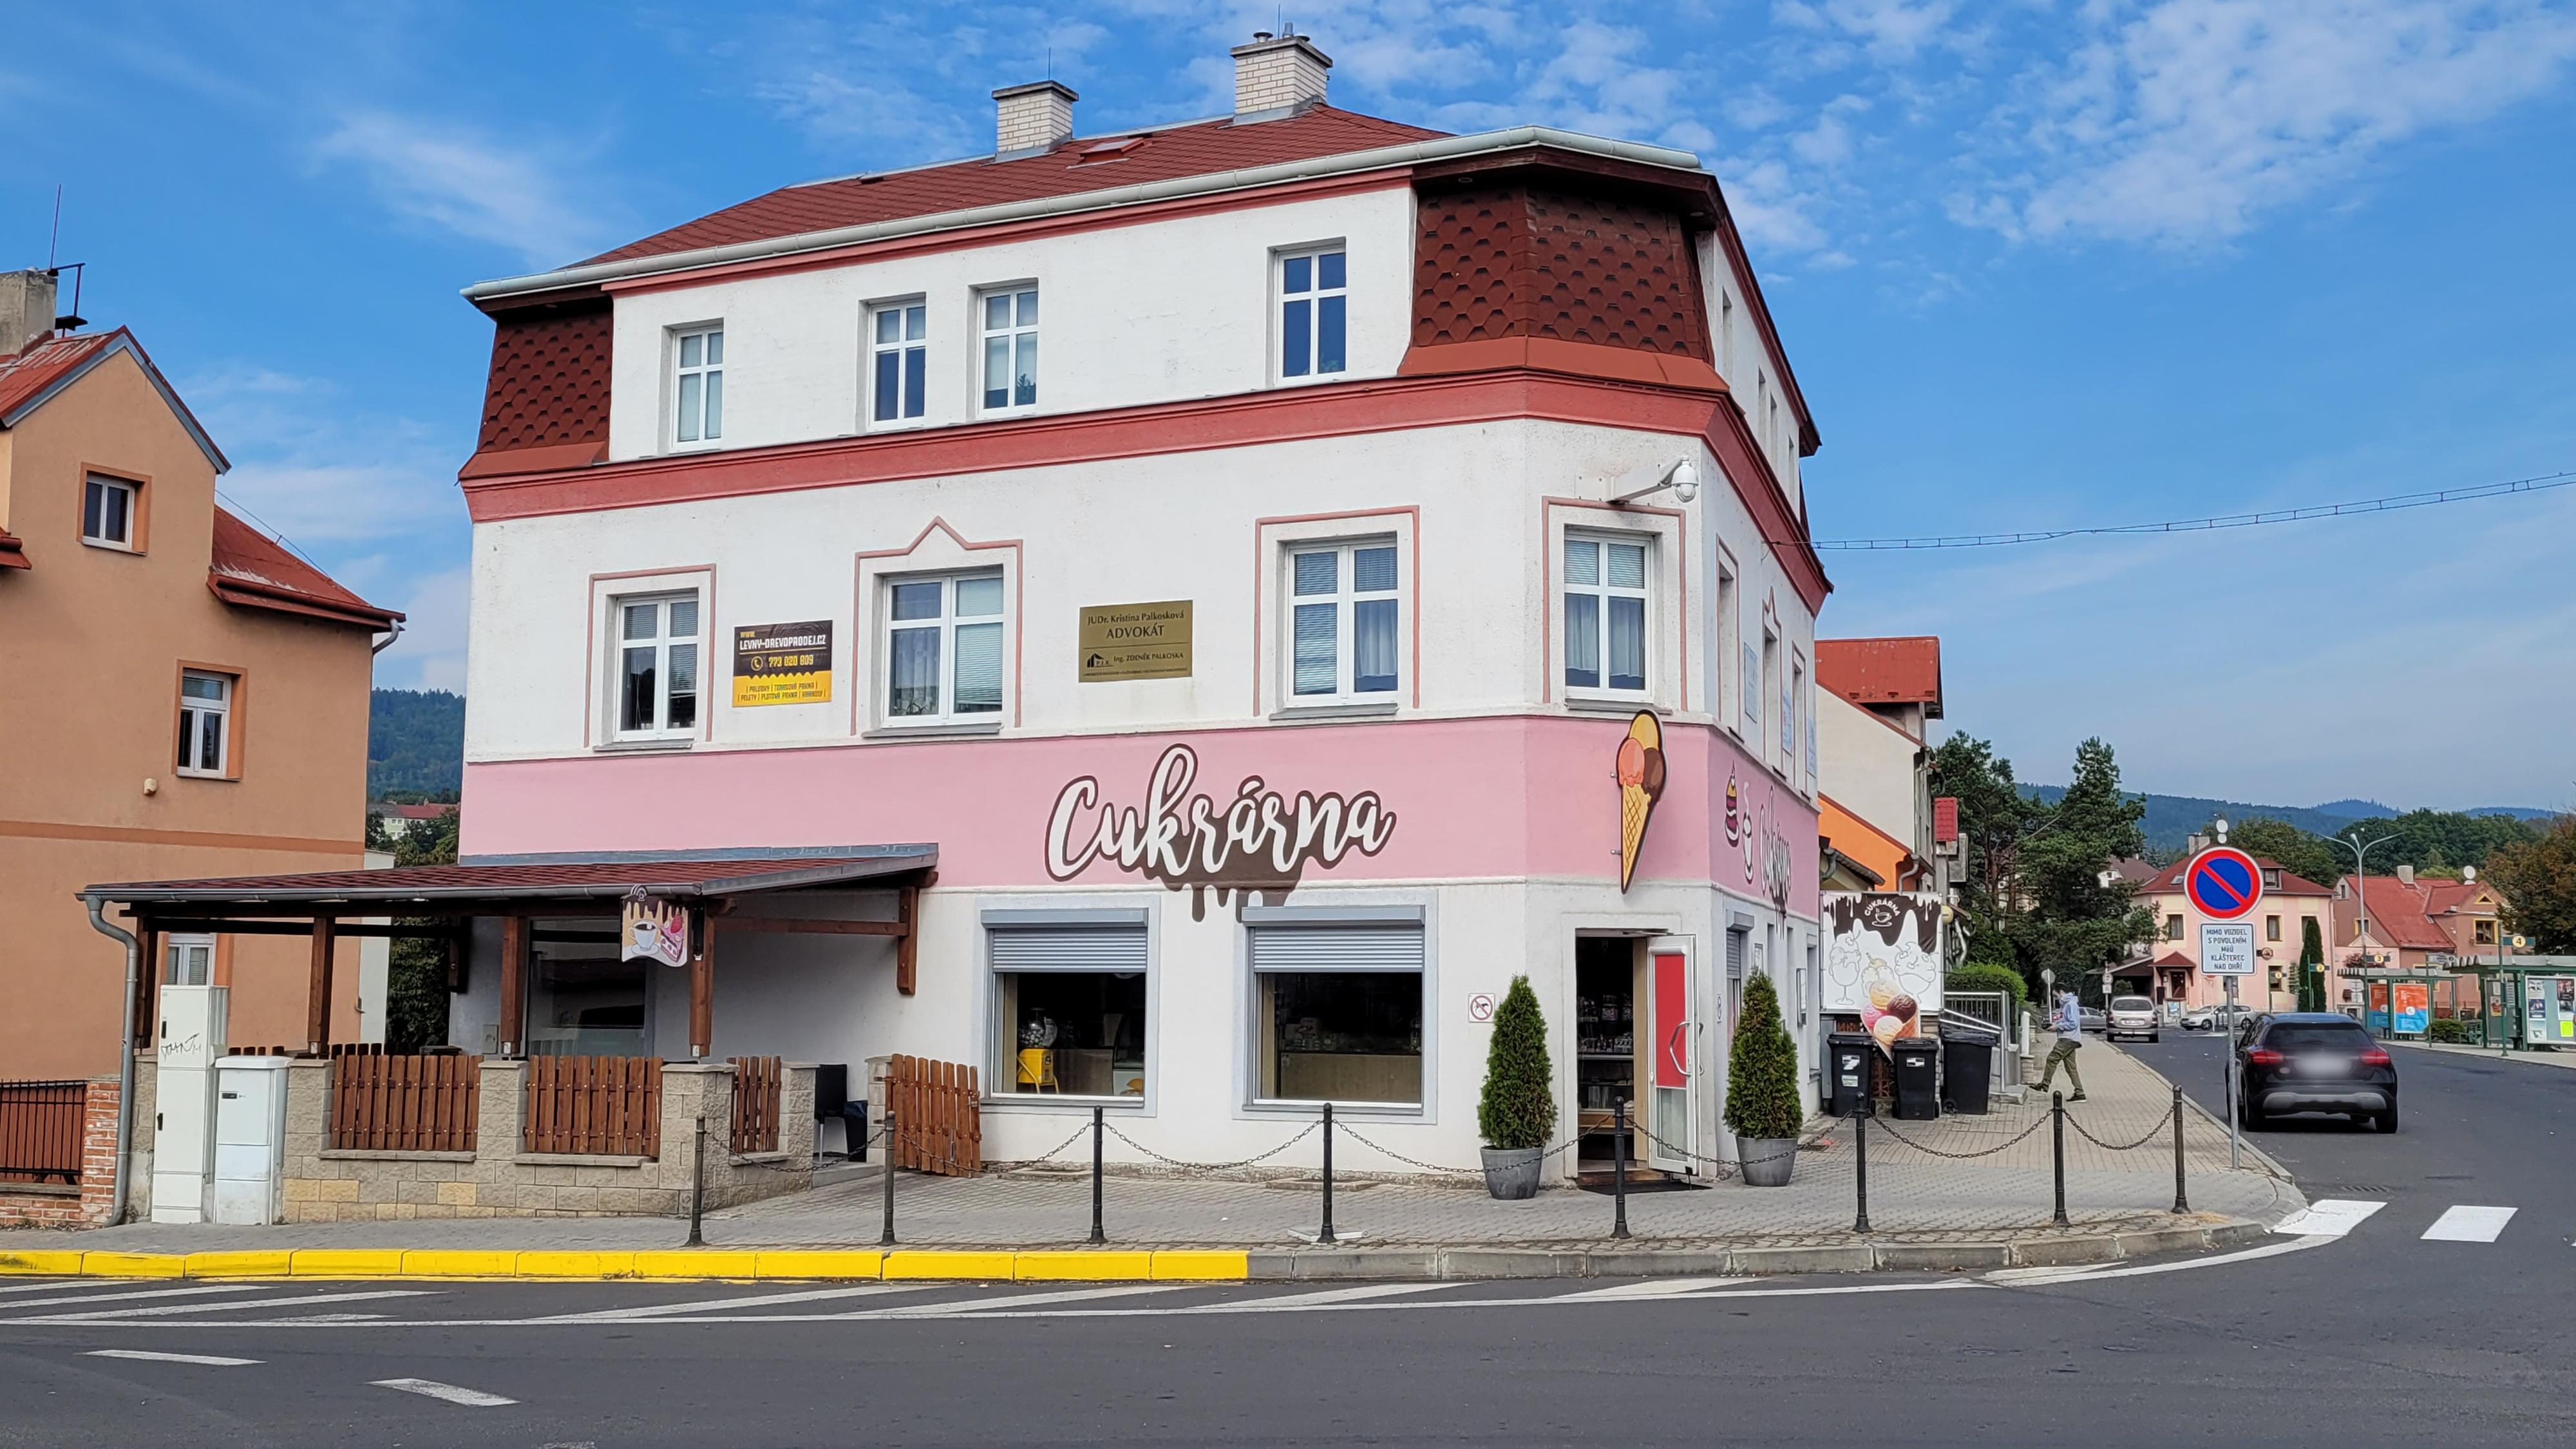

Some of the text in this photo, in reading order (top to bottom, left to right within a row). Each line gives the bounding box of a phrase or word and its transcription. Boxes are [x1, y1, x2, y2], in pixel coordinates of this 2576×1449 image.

[1088, 611, 1184, 625] JUDr. Kristina Palkosková
[1106, 622, 1164, 639] ADVOKÁT
[1046, 744, 1395, 880] Cukrárna
[1864, 898, 1901, 917] CUKRÁRNA
[2213, 936, 2247, 944] POVOLENÍM
[2211, 953, 2245, 961] KLÁŠTEREC
